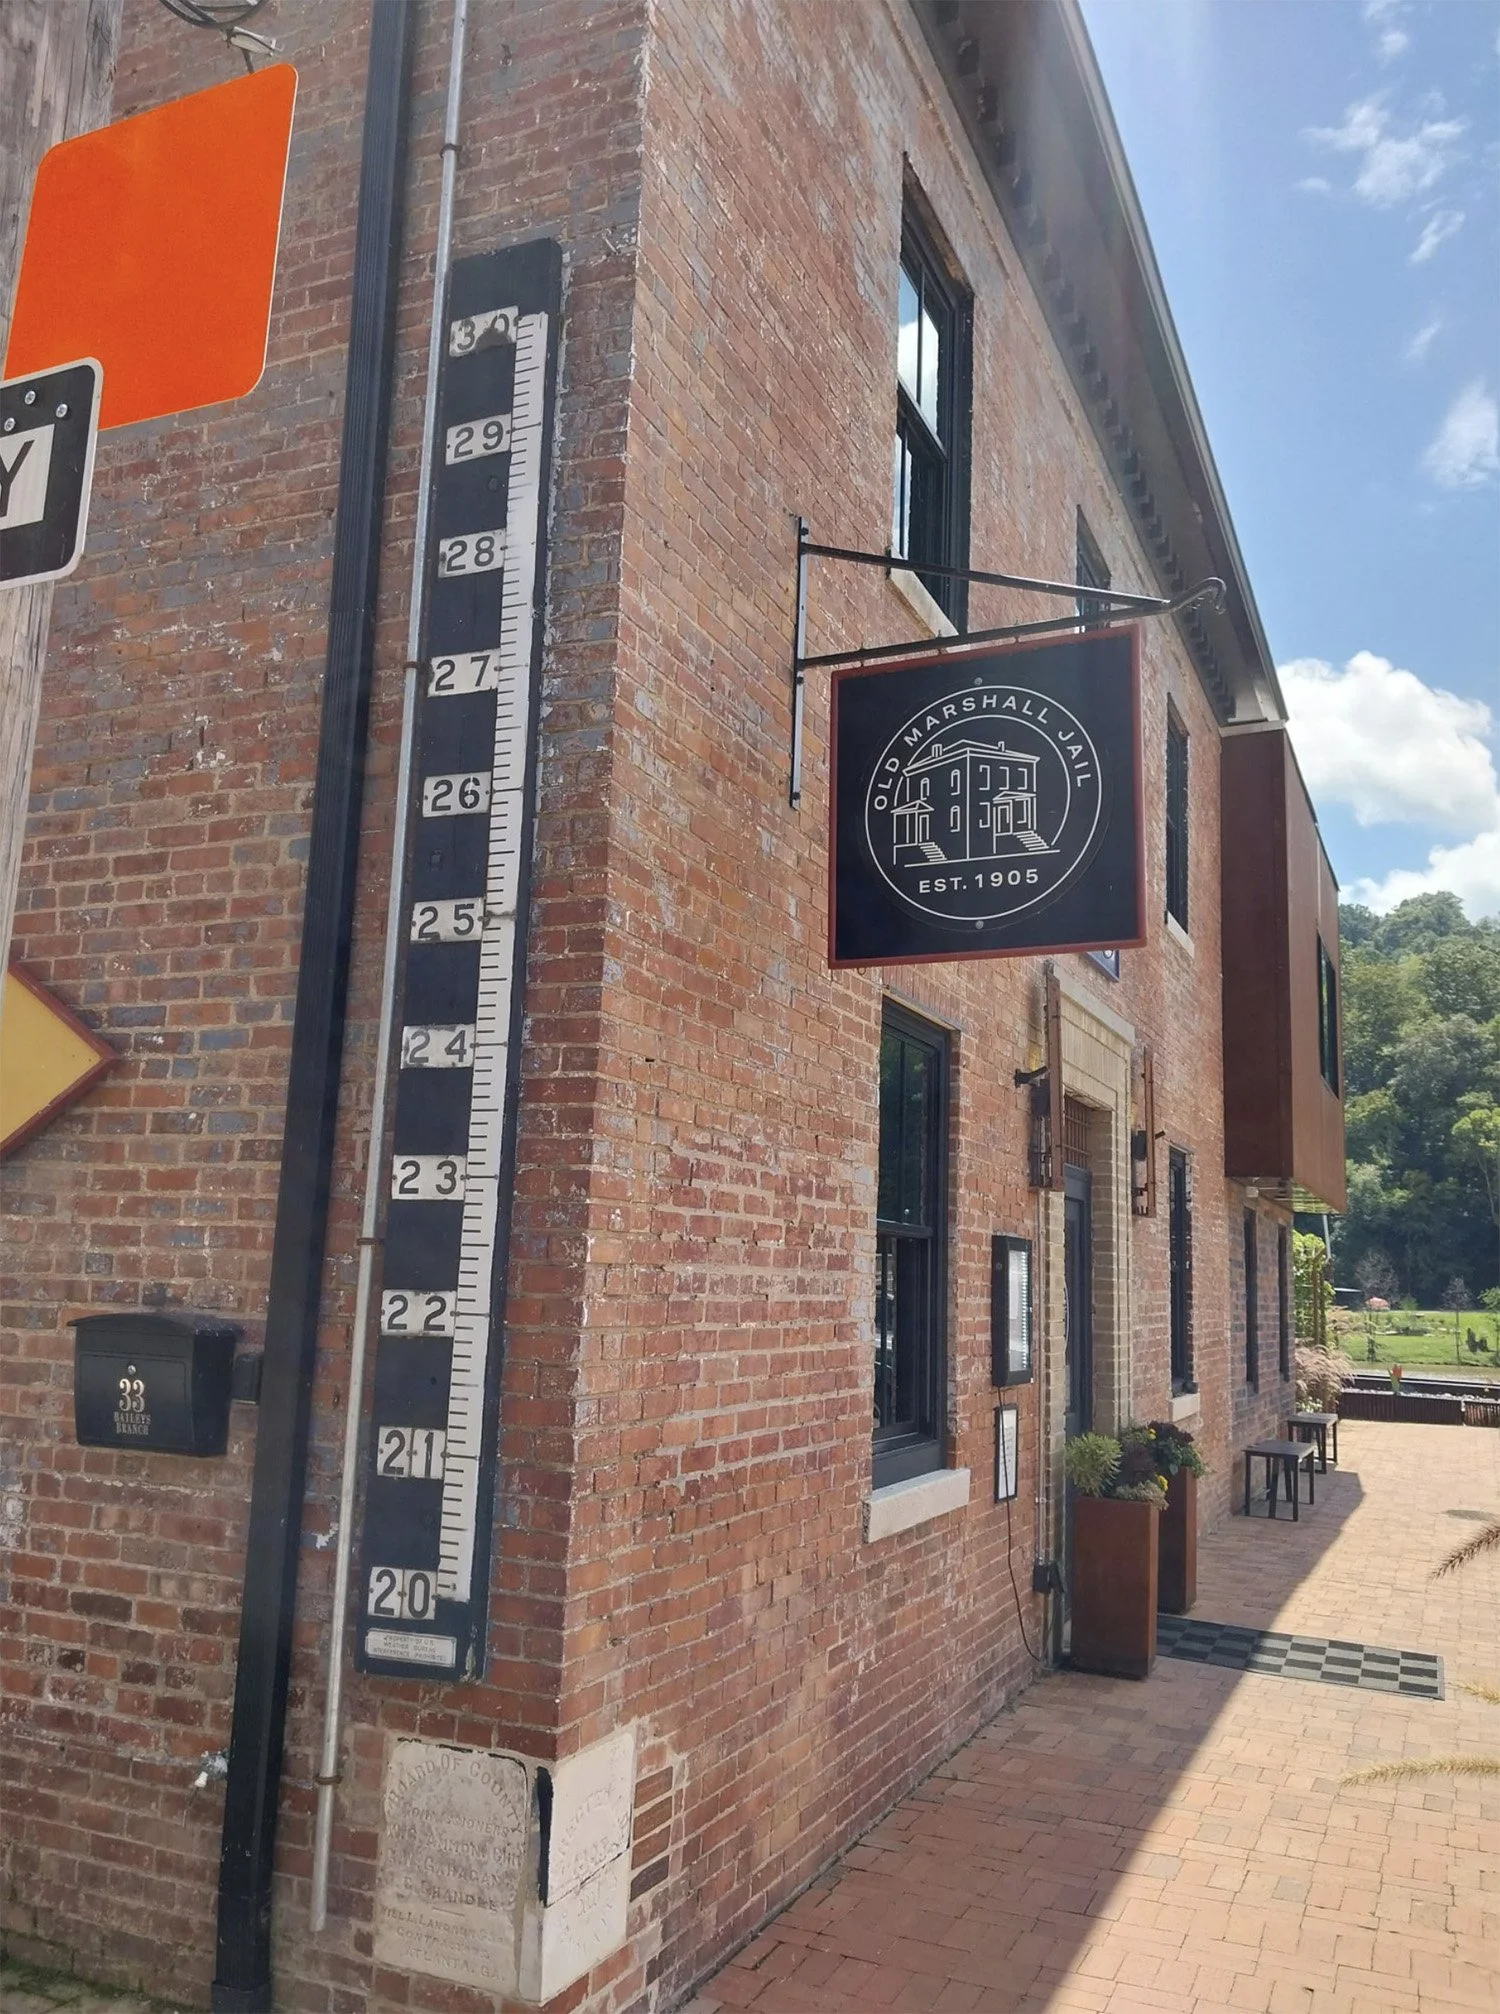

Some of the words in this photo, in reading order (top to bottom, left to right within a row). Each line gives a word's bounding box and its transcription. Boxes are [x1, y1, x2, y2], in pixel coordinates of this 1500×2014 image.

[453, 419, 504, 458] 29
[446, 535, 496, 572] 28
[434, 654, 490, 692] 27
[874, 756, 900, 810] OLD
[904, 694, 1048, 748] MARSHALL
[1058, 729, 1091, 788] JAIL
[430, 776, 482, 812] 26
[918, 876, 968, 895] EST.
[974, 867, 1040, 889] 1905
[418, 903, 475, 940] 25
[408, 1029, 468, 1064] 24
[399, 1160, 458, 1195] 23
[387, 1294, 446, 1332] 22
[119, 1378, 145, 1412] 33
[116, 1422, 149, 1435] BRANCH
[382, 1430, 435, 1478] 21
[373, 1568, 431, 1619] 20
[441, 1753, 463, 1772] OF
[470, 1761, 524, 1834] COUNTY
